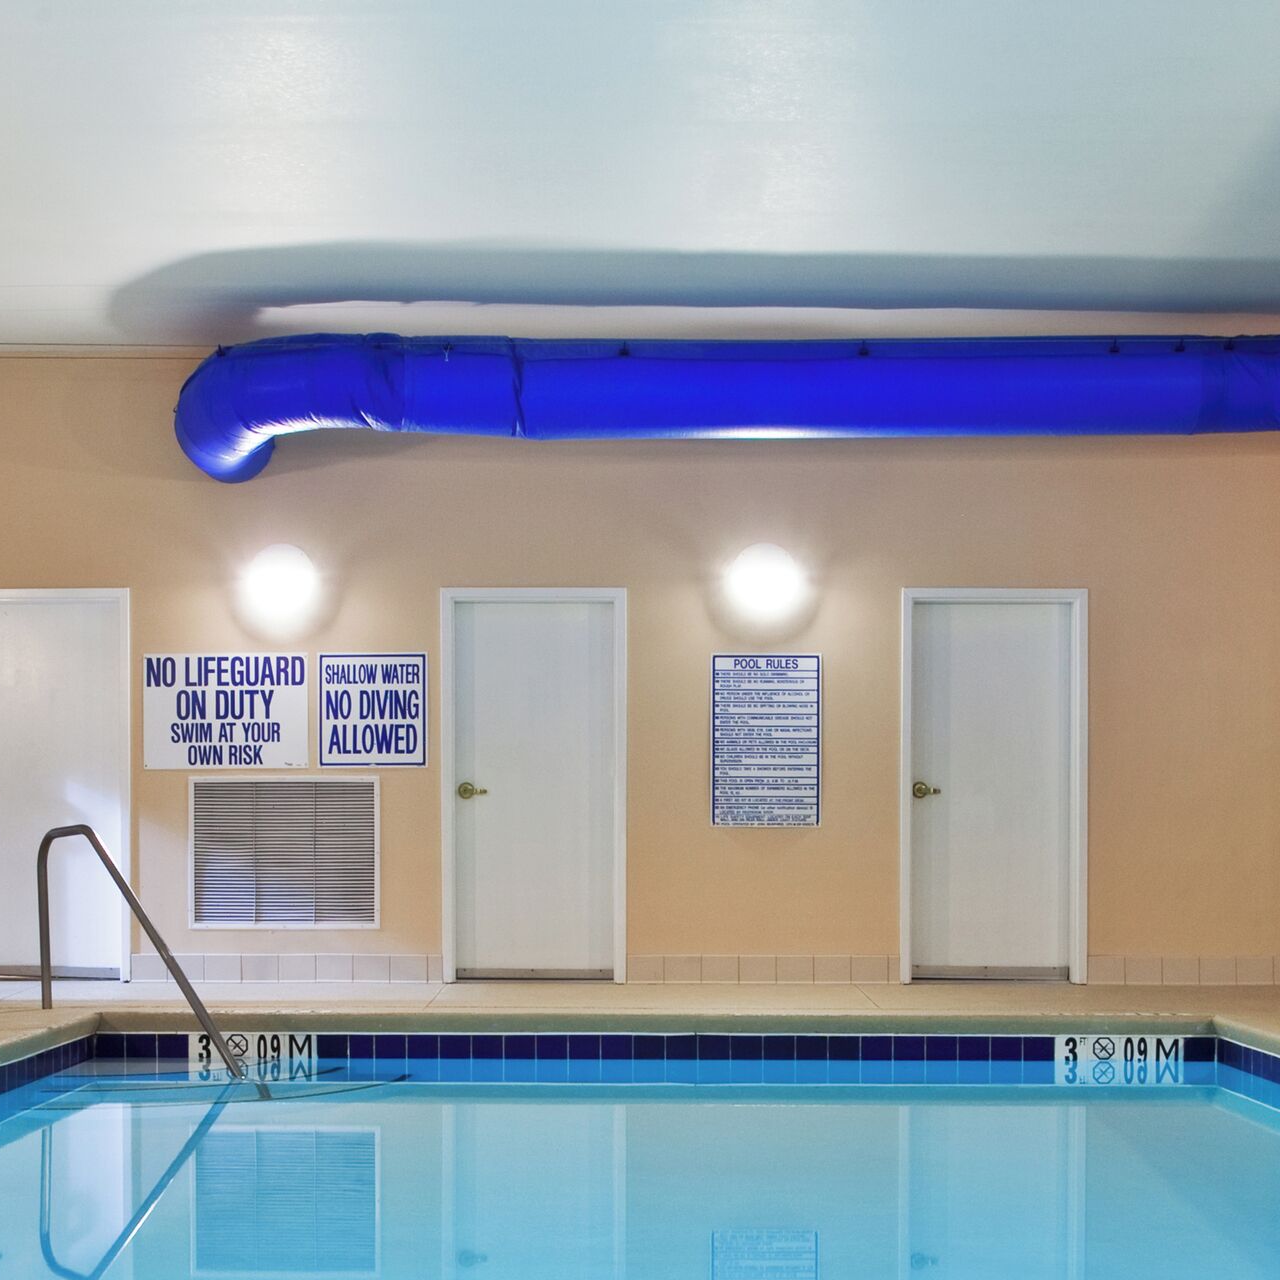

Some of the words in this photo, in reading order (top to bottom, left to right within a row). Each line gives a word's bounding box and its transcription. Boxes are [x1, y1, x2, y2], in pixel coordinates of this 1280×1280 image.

[145, 656, 177, 688] NO
[184, 656, 305, 687] LIFEGUARD
[325, 664, 378, 684] SHALLOW
[380, 664, 420, 684] WATER
[733, 658, 762, 669] POOL
[765, 658, 799, 669] RULES
[176, 689, 206, 720] ON
[215, 689, 275, 720] DUTY
[325, 690, 352, 720] NO
[359, 690, 420, 720] DIVING
[170, 722, 213, 743] SWIM
[218, 722, 236, 742] AT
[241, 722, 281, 743] YOUR
[328, 723, 418, 755] ALLOWED
[187, 745, 224, 766] OWN
[228, 745, 264, 765] RISK
